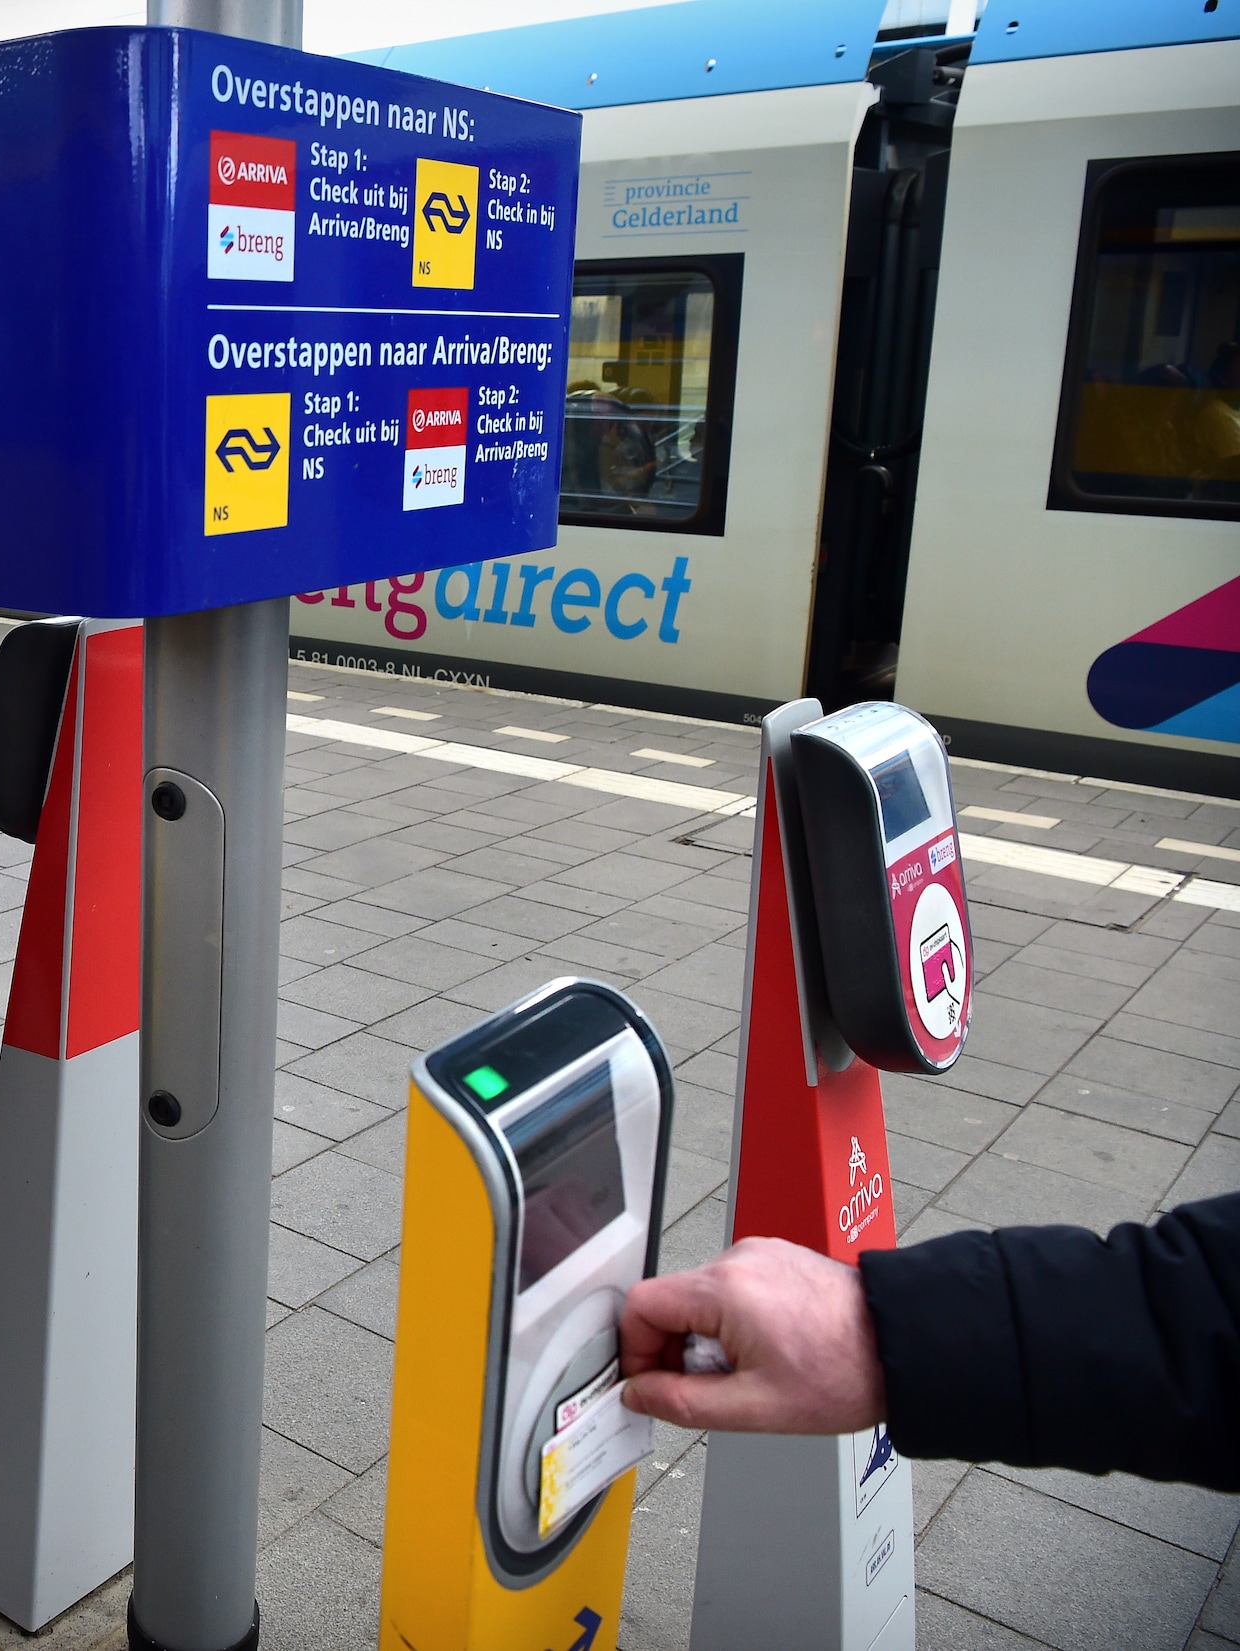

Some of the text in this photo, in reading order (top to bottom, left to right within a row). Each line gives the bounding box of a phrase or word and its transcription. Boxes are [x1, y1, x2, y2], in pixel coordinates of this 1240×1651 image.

[210, 63, 476, 142] Overstappen naar NS:
[310, 141, 368, 173] Stap 1:
[237, 161, 288, 185] ARRIVA
[488, 168, 531, 195] Stap 2:
[309, 177, 408, 215] Check uit bij
[625, 177, 712, 205] provincie
[487, 199, 556, 232] Check in bij
[612, 202, 739, 229] Gelderland
[236, 225, 284, 262] breng
[308, 212, 410, 249] Arriva/Breng
[486, 229, 503, 251] NS
[418, 261, 432, 276] NS
[207, 333, 553, 375] Overstappen naar Arriva/Breng:
[303, 391, 360, 416] Stap 1:
[478, 385, 520, 407] Stap 2:
[425, 409, 462, 427] ARRIVA
[476, 409, 543, 436] Check in bij
[303, 418, 400, 448] Check uit bij
[475, 438, 549, 464] Arriva/Breng
[302, 457, 325, 481] NS
[423, 462, 458, 489] breng
[212, 505, 230, 522] NS
[936, 842, 955, 862] breng
[900, 862, 923, 887] arriva
[839, 1173, 883, 1232] arriva
